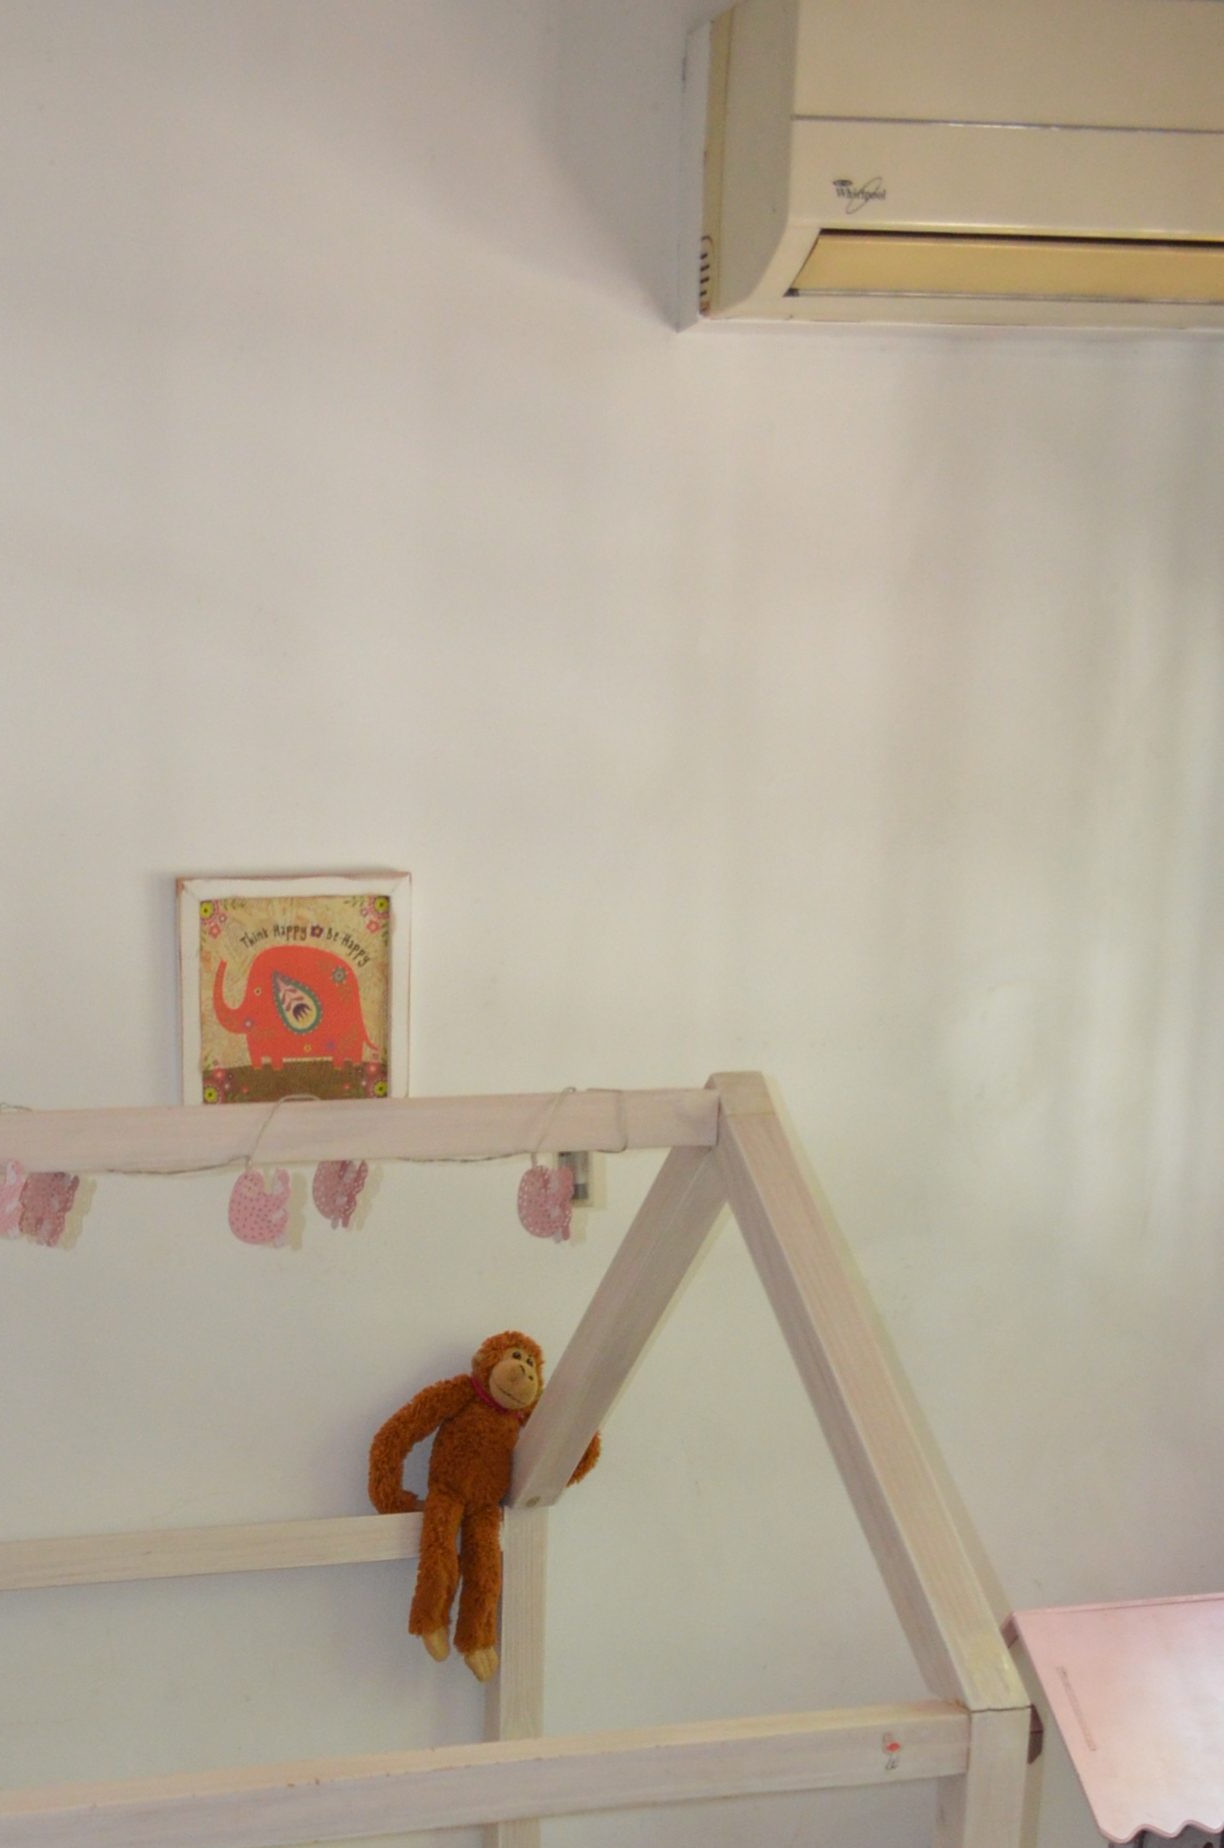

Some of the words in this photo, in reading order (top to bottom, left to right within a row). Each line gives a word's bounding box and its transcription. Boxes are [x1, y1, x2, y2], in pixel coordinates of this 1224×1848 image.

[239, 928, 268, 948] Think
[273, 924, 307, 941] Happy
[341, 934, 371, 967] Happy
